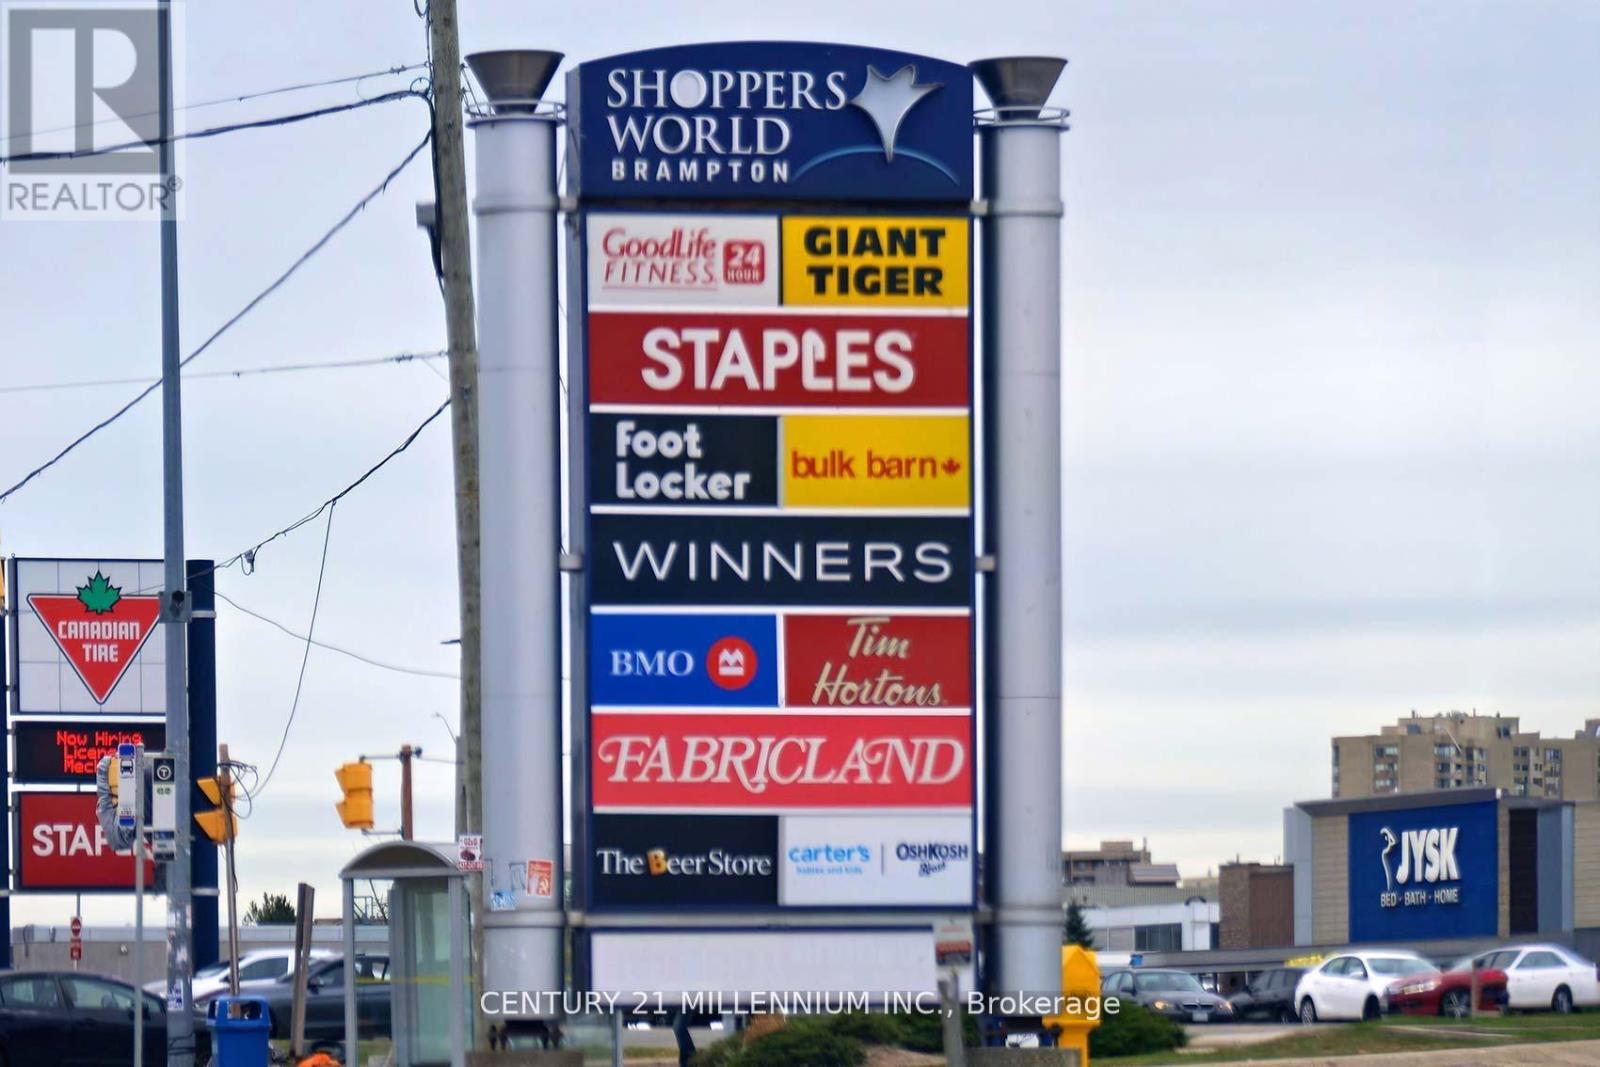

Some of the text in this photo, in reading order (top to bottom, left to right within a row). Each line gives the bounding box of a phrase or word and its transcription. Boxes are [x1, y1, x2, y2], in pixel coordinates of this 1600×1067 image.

[607, 69, 847, 110] SHOPPERS
[607, 115, 790, 155] WORLD
[612, 160, 788, 182] BRAMPTON
[602, 227, 717, 259] GoodLife
[727, 244, 760, 267] 24
[804, 227, 946, 257] GIANT
[727, 269, 760, 282] HOUR
[807, 266, 943, 296] TIGER
[641, 327, 915, 393] STAPLES
[616, 420, 702, 459] Foot
[792, 451, 937, 479] bulk barn
[616, 462, 751, 500] Locker
[613, 542, 952, 582] WINNERS
[57, 620, 140, 640] CANADIAN
[847, 616, 910, 659] Tim
[82, 644, 118, 663] TIRE
[611, 650, 694, 676] BMO
[812, 662, 942, 705] Hortons
[56, 731, 87, 745] Now
[598, 736, 965, 793] FABRICLAND
[597, 848, 772, 876] The Beer Store
[788, 844, 870, 863] carter's
[896, 843, 968, 861] OSHKOSH
[1396, 827, 1459, 884] JYSK
[1380, 889, 1458, 907] BED BATH HOME
